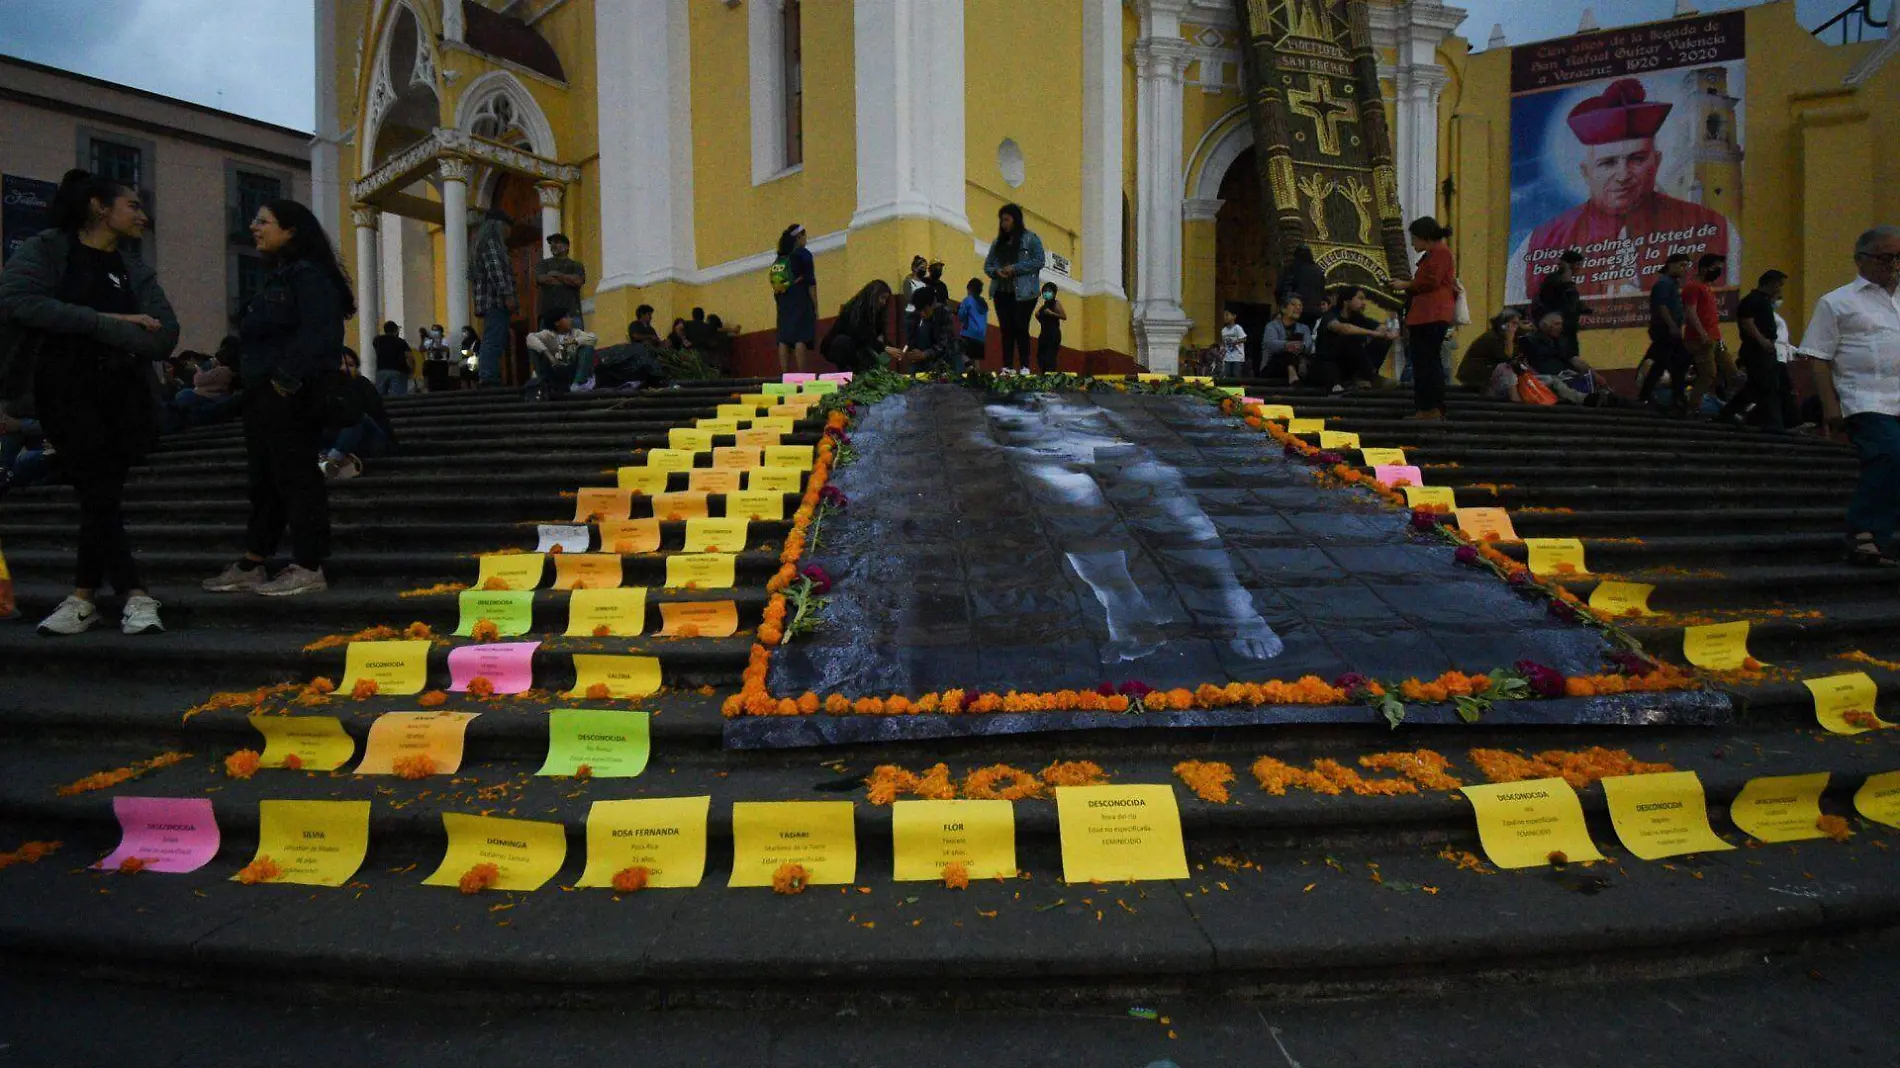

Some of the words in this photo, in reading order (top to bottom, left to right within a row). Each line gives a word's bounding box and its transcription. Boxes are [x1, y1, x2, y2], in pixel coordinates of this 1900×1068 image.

[1610, 35, 1626, 47] de
[1703, 20, 1720, 33] de
[1552, 64, 1613, 81] Veracruz
[1625, 55, 1661, 71] 1920
[1678, 47, 1718, 63] 2020
[1566, 50, 1610, 68] Rafael
[1585, 236, 1632, 254] colme
[1649, 228, 1694, 244] Usted
[1697, 224, 1718, 238] de
[1645, 247, 1661, 260] lo
[1667, 242, 1707, 257] llene
[577, 733, 627, 742] DESCONOCIDA
[1496, 791, 1549, 802] DESCONOCIDA
[1088, 798, 1147, 809] DESCONOCIDA
[1636, 801, 1684, 812] DESCONOCIDA
[611, 829, 633, 839] ROSA
[634, 826, 681, 838] FERNANDA
[943, 823, 965, 832] FLOR
[486, 836, 528, 850] DOMINGA
